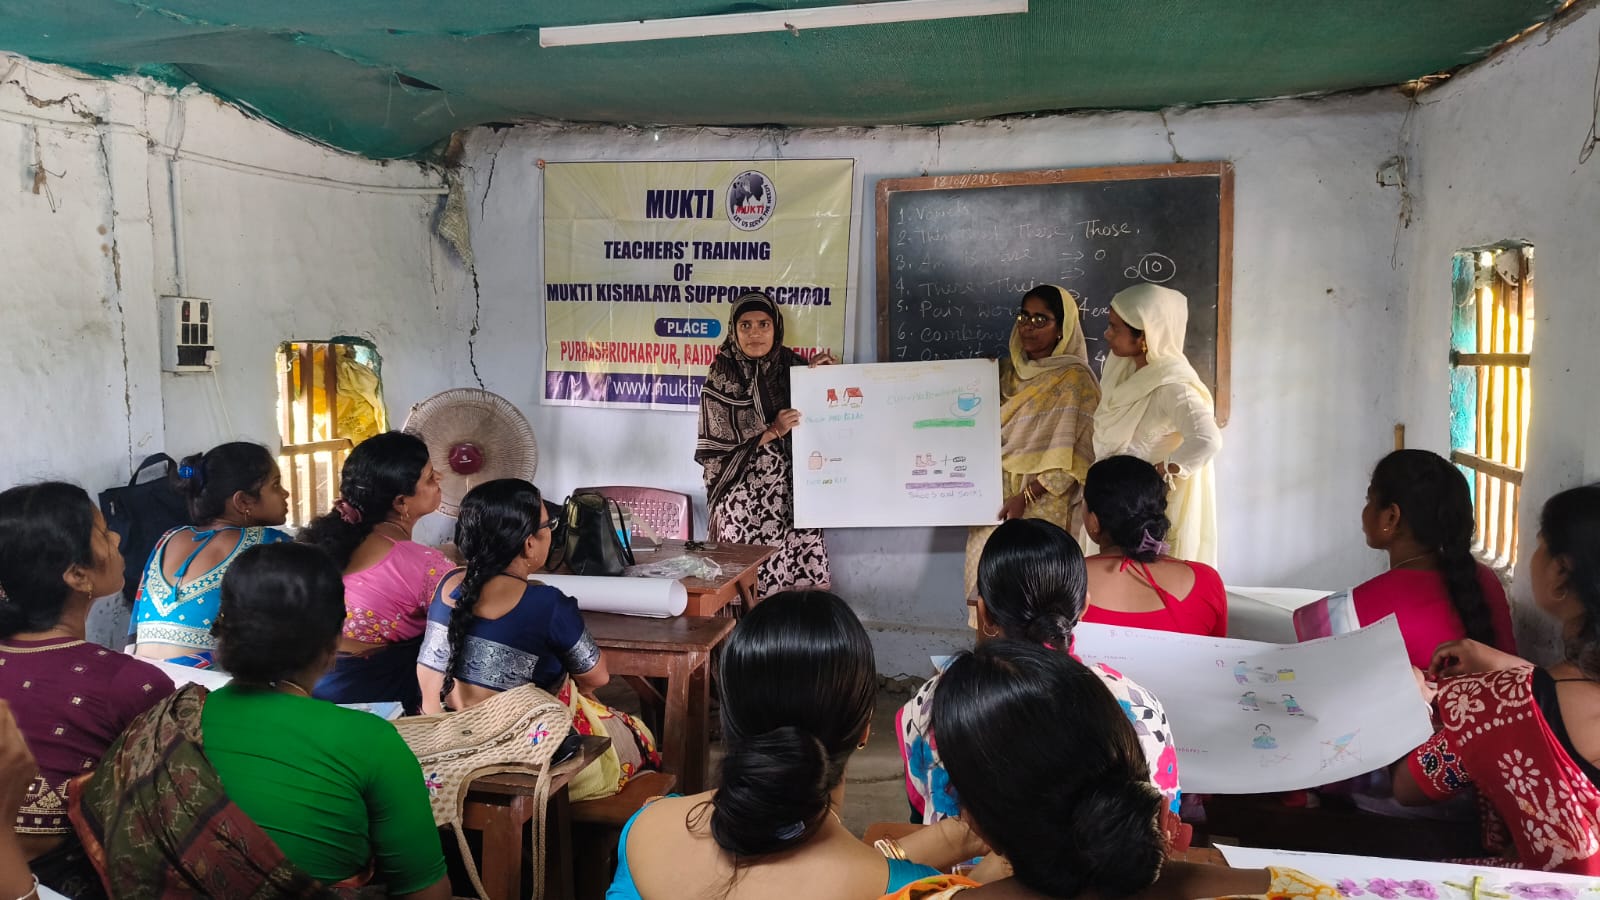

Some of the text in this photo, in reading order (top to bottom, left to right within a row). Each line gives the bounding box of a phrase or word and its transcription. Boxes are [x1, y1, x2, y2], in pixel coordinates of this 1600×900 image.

[646, 190, 714, 219] MUKTI
[736, 206, 764, 214] MUKTI
[604, 241, 771, 260] TEACHERS' TRAINING
[673, 262, 693, 282] OF
[547, 284, 593, 302] MUKTI
[596, 284, 682, 302] KISHALAYA
[765, 286, 831, 306] SCHOOL
[667, 322, 708, 334] PLACE
